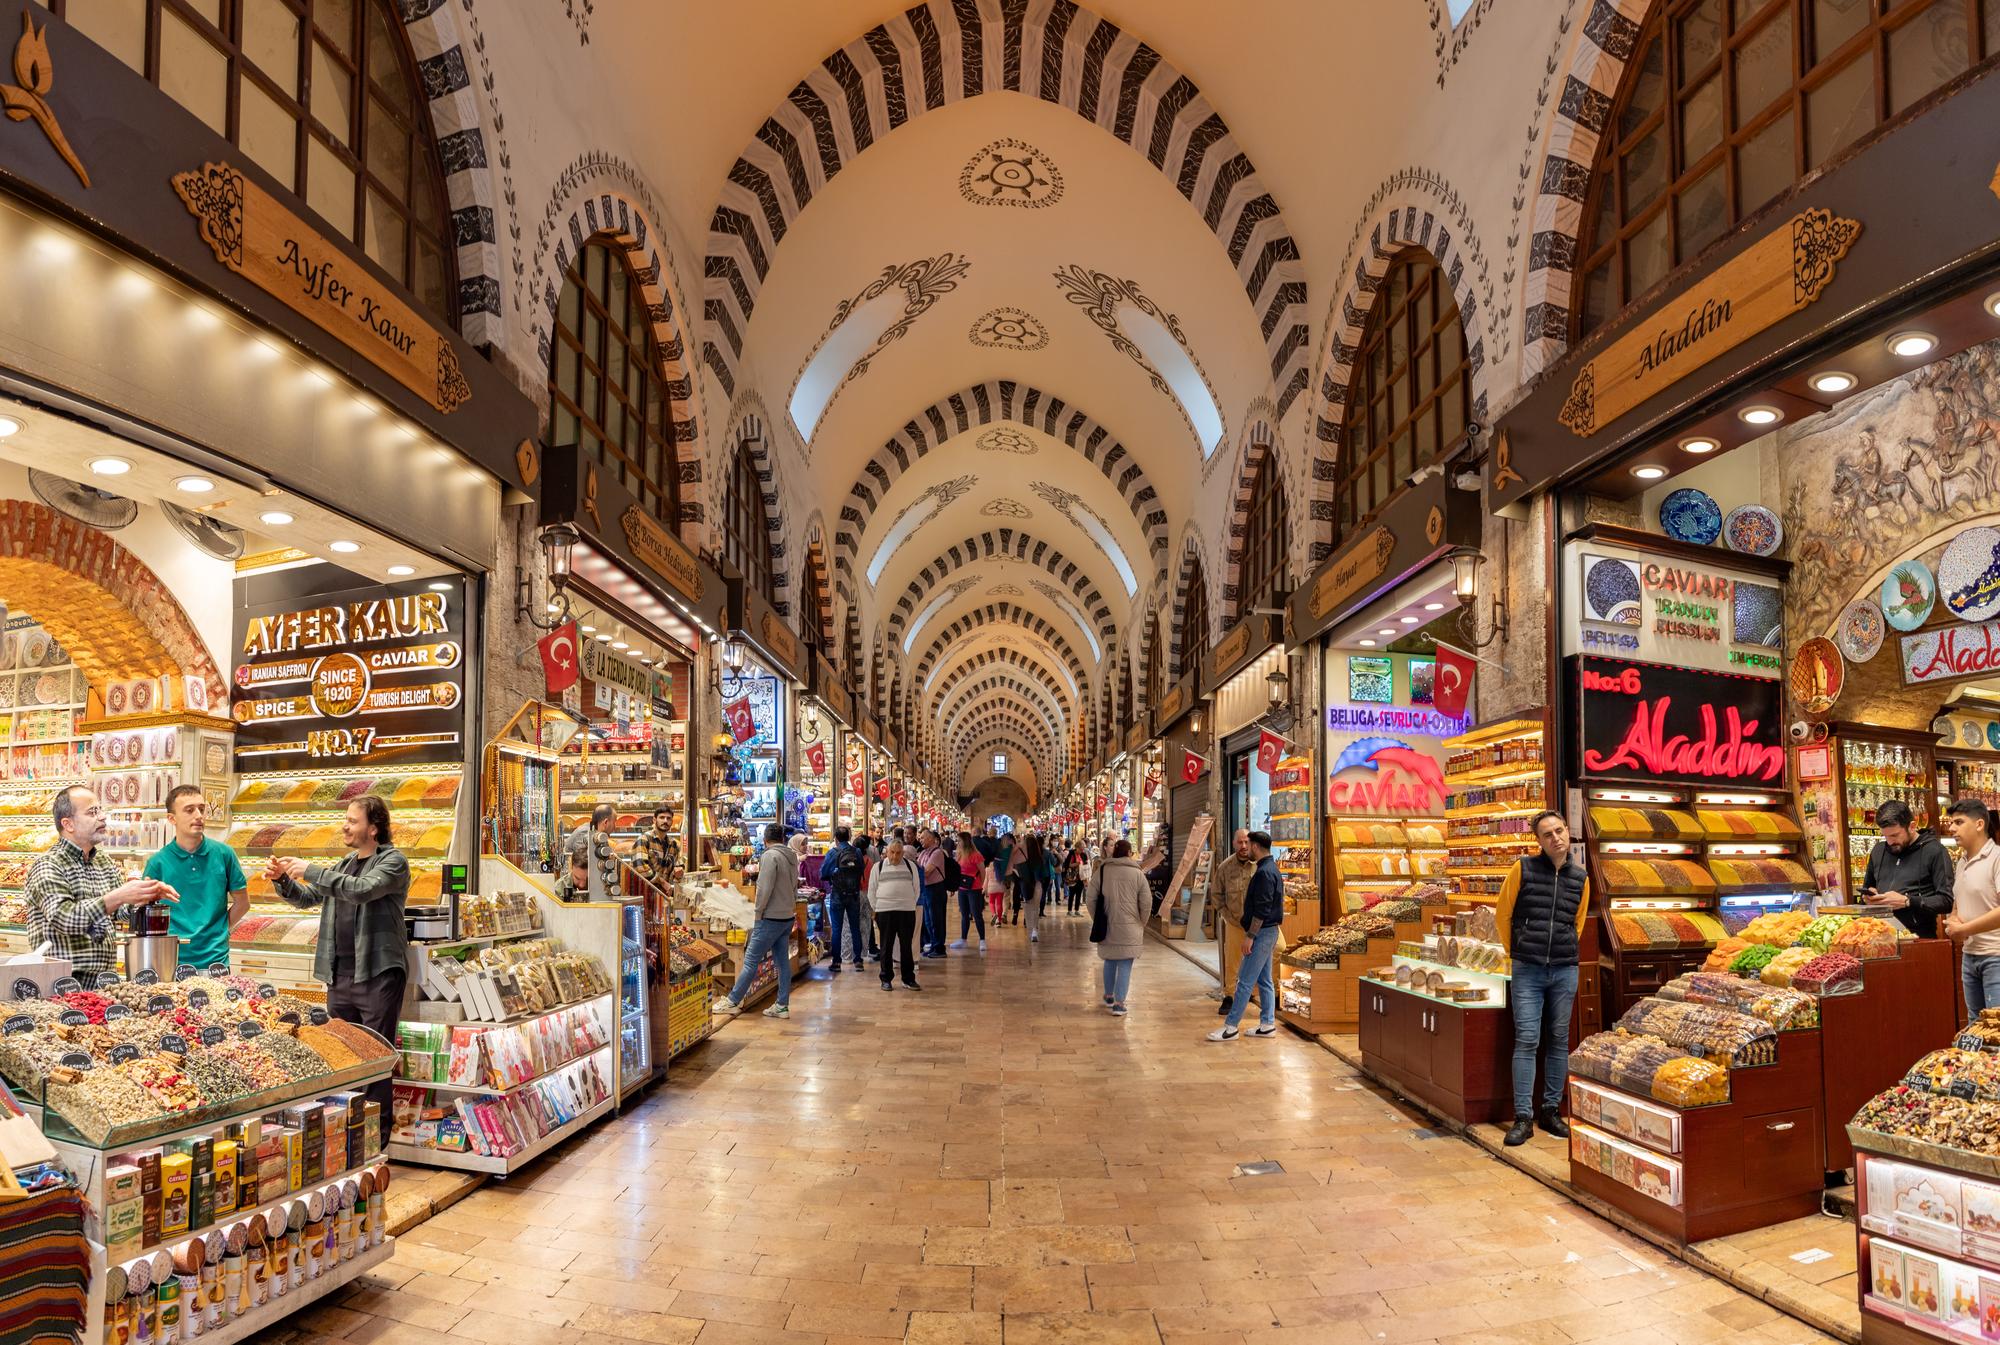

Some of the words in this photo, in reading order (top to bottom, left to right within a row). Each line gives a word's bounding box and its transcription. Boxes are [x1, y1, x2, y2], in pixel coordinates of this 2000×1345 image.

[277, 239, 354, 307] Ayfer
[358, 297, 417, 355] Kaur
[1635, 298, 1733, 379] Aladdin
[526, 451, 532, 471] 7
[641, 527, 662, 557] Borsa
[1334, 561, 1358, 591] Hayat
[1643, 563, 1730, 601] CAVIAR
[243, 606, 346, 656] AYFER
[349, 592, 449, 644] KAUR
[371, 649, 429, 668] CAVIAR
[597, 651, 605, 677] LA
[251, 667, 277, 682] IRANIAN
[278, 663, 307, 679] SAFFRON
[319, 668, 357, 686] SINCE
[1583, 667, 1642, 694] No:6
[323, 686, 352, 703] 1920
[369, 691, 400, 707] TURKISH
[400, 688, 431, 705] DELIGHT
[255, 701, 295, 717] SPICE
[1585, 695, 1784, 780] Aladdin
[1329, 768, 1432, 810] CAVIAR
[1852, 828, 1873, 836] NATURAL
[1961, 1035, 1979, 1046] LOVE
[1961, 1042, 1976, 1052] TEA
[1910, 1076, 1931, 1086] RELAX
